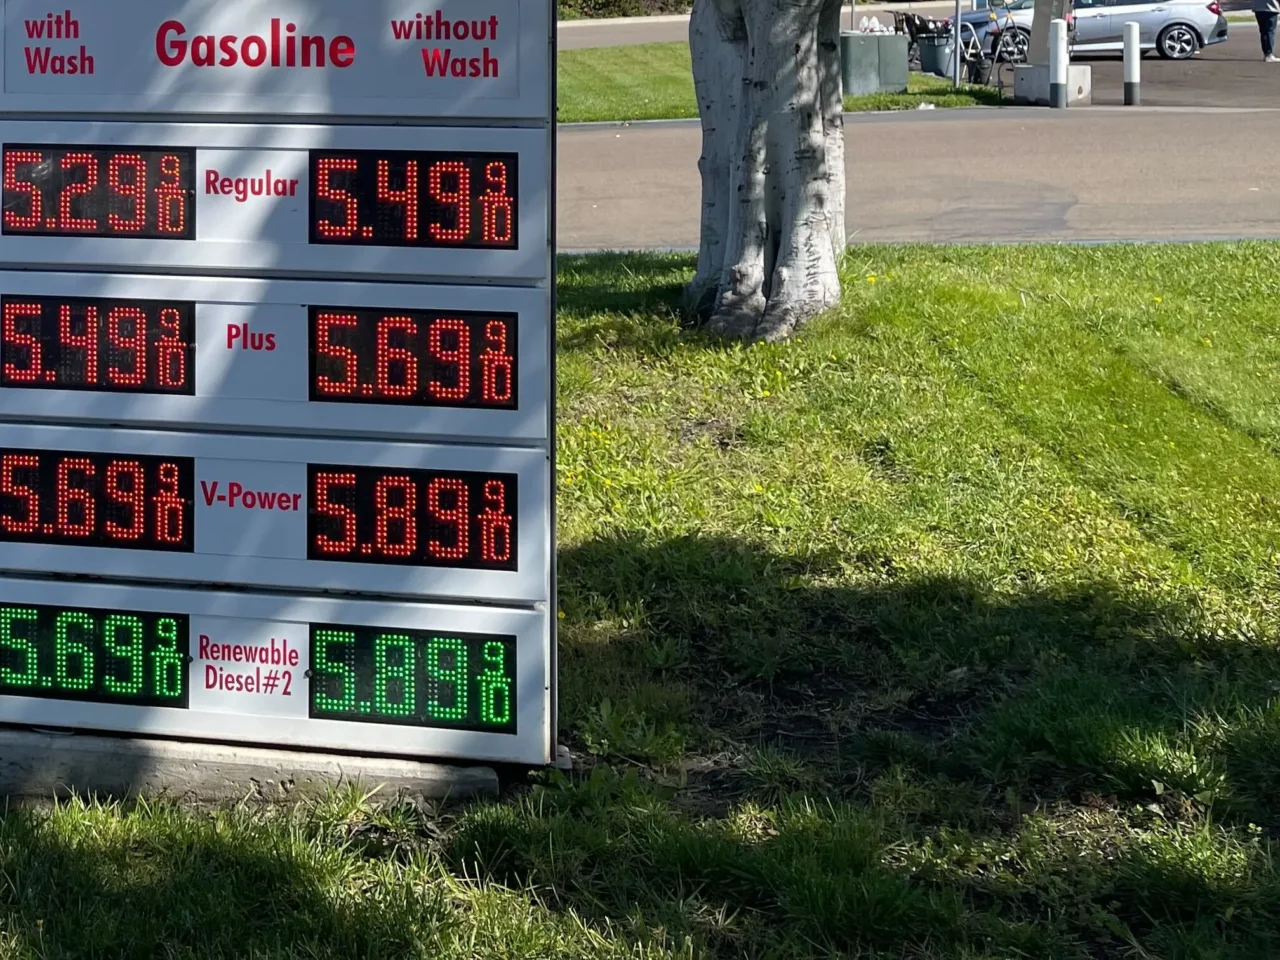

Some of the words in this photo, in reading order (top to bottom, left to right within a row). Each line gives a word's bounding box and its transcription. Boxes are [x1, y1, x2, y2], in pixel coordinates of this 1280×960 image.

[24, 10, 79, 39] with
[391, 10, 499, 41] without
[156, 18, 356, 68] Gasoline
[24, 47, 94, 75] Wash
[421, 48, 499, 78] Wash
[205, 169, 299, 203] Regular
[226, 323, 276, 352] Plus
[200, 481, 302, 512] V-Power
[199, 635, 300, 667] Renewable
